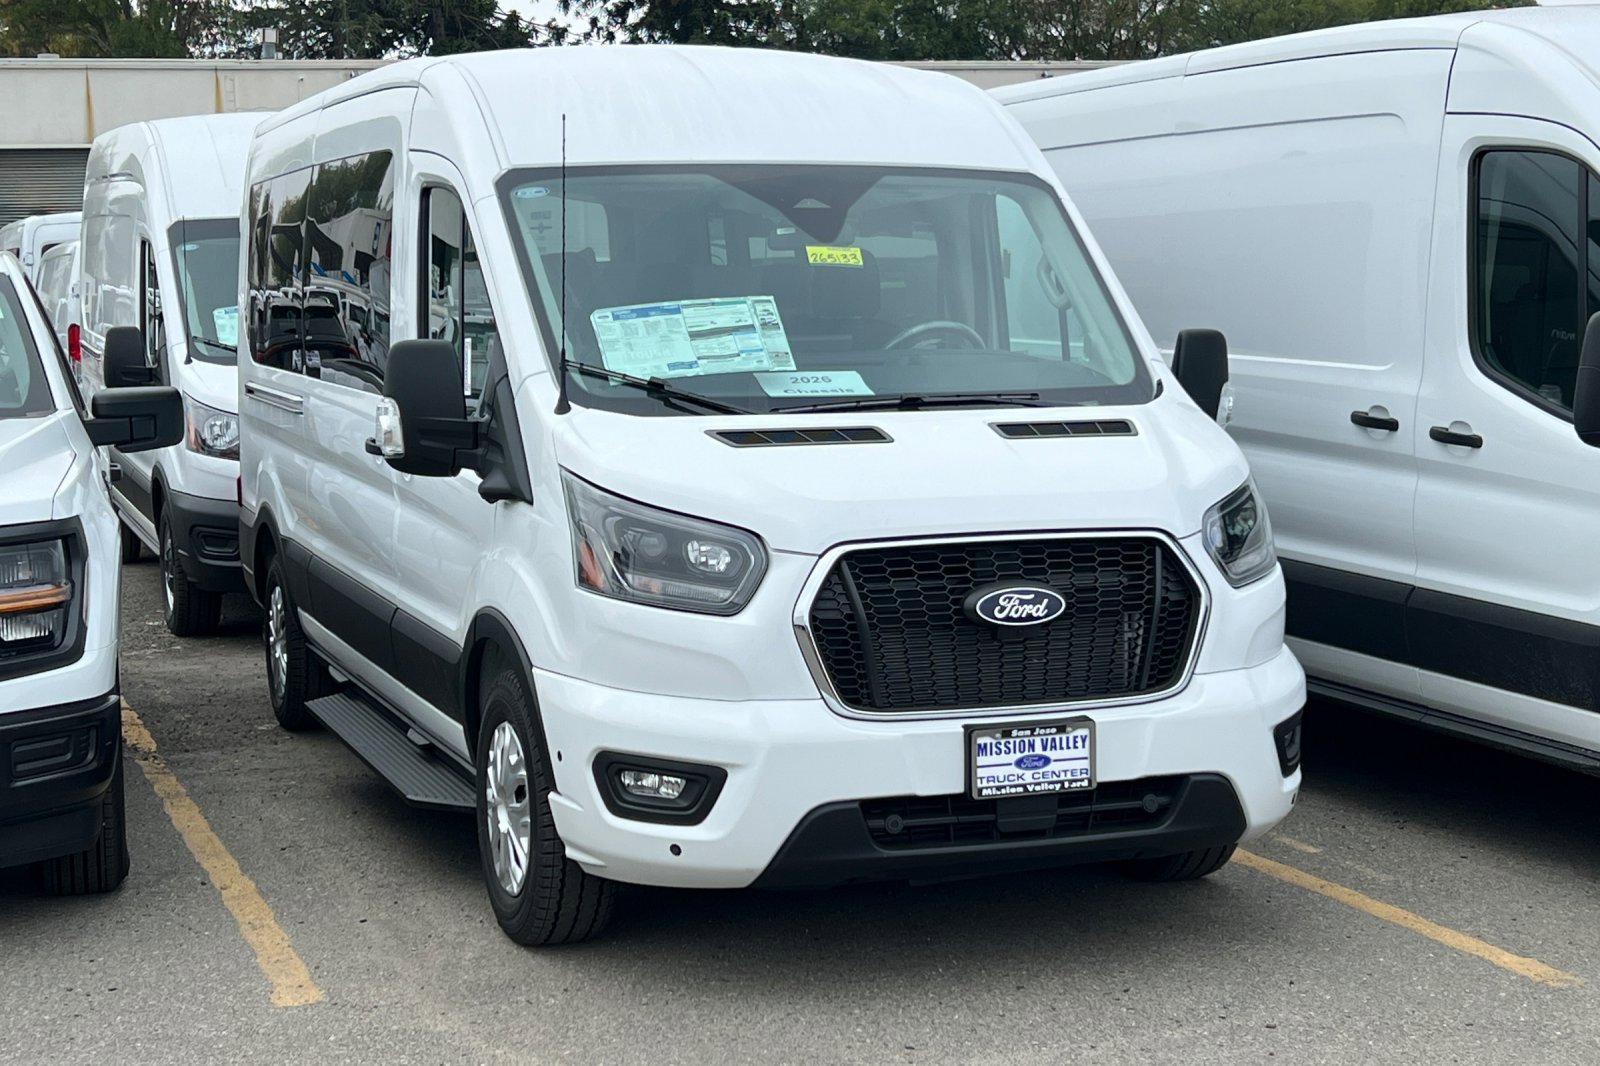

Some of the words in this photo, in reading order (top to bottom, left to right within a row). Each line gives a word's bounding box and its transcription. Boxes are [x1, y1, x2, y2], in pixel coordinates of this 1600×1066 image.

[810, 252, 861, 264] 265133
[789, 376, 833, 384] 2026
[993, 593, 1049, 619] Ford
[1010, 728, 1031, 737] San
[977, 738, 1036, 757] MISSION
[1040, 734, 1088, 752] VALLEY
[1020, 756, 1045, 768] Ford
[977, 773, 1026, 785] TRUCK
[1031, 768, 1089, 780] CENTER
